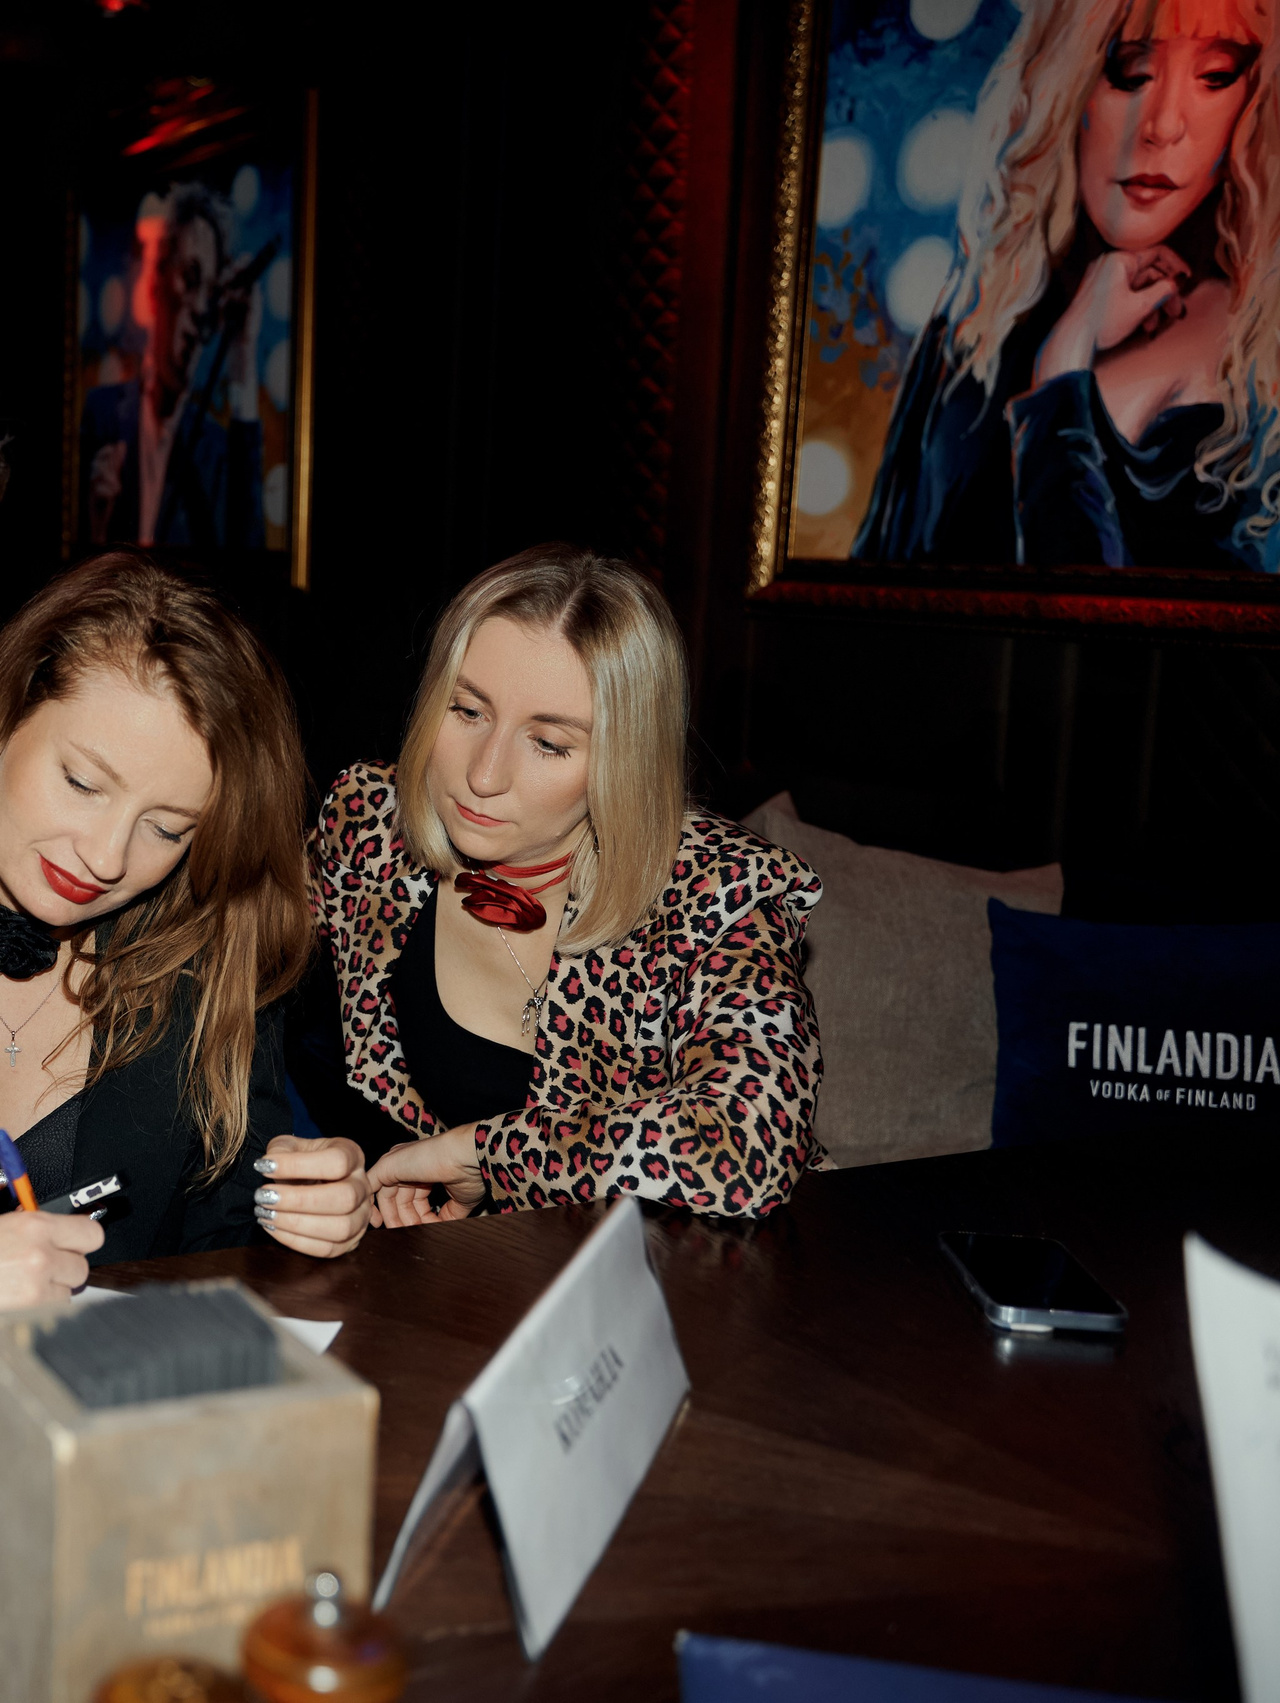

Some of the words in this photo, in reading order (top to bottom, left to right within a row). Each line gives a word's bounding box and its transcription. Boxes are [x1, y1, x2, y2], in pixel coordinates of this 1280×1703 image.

[1067, 1021, 1280, 1085] FINLANDIA
[1089, 1079, 1150, 1102] VODKA
[1156, 1089, 1171, 1101] OF
[1175, 1087, 1256, 1111] FINLAND
